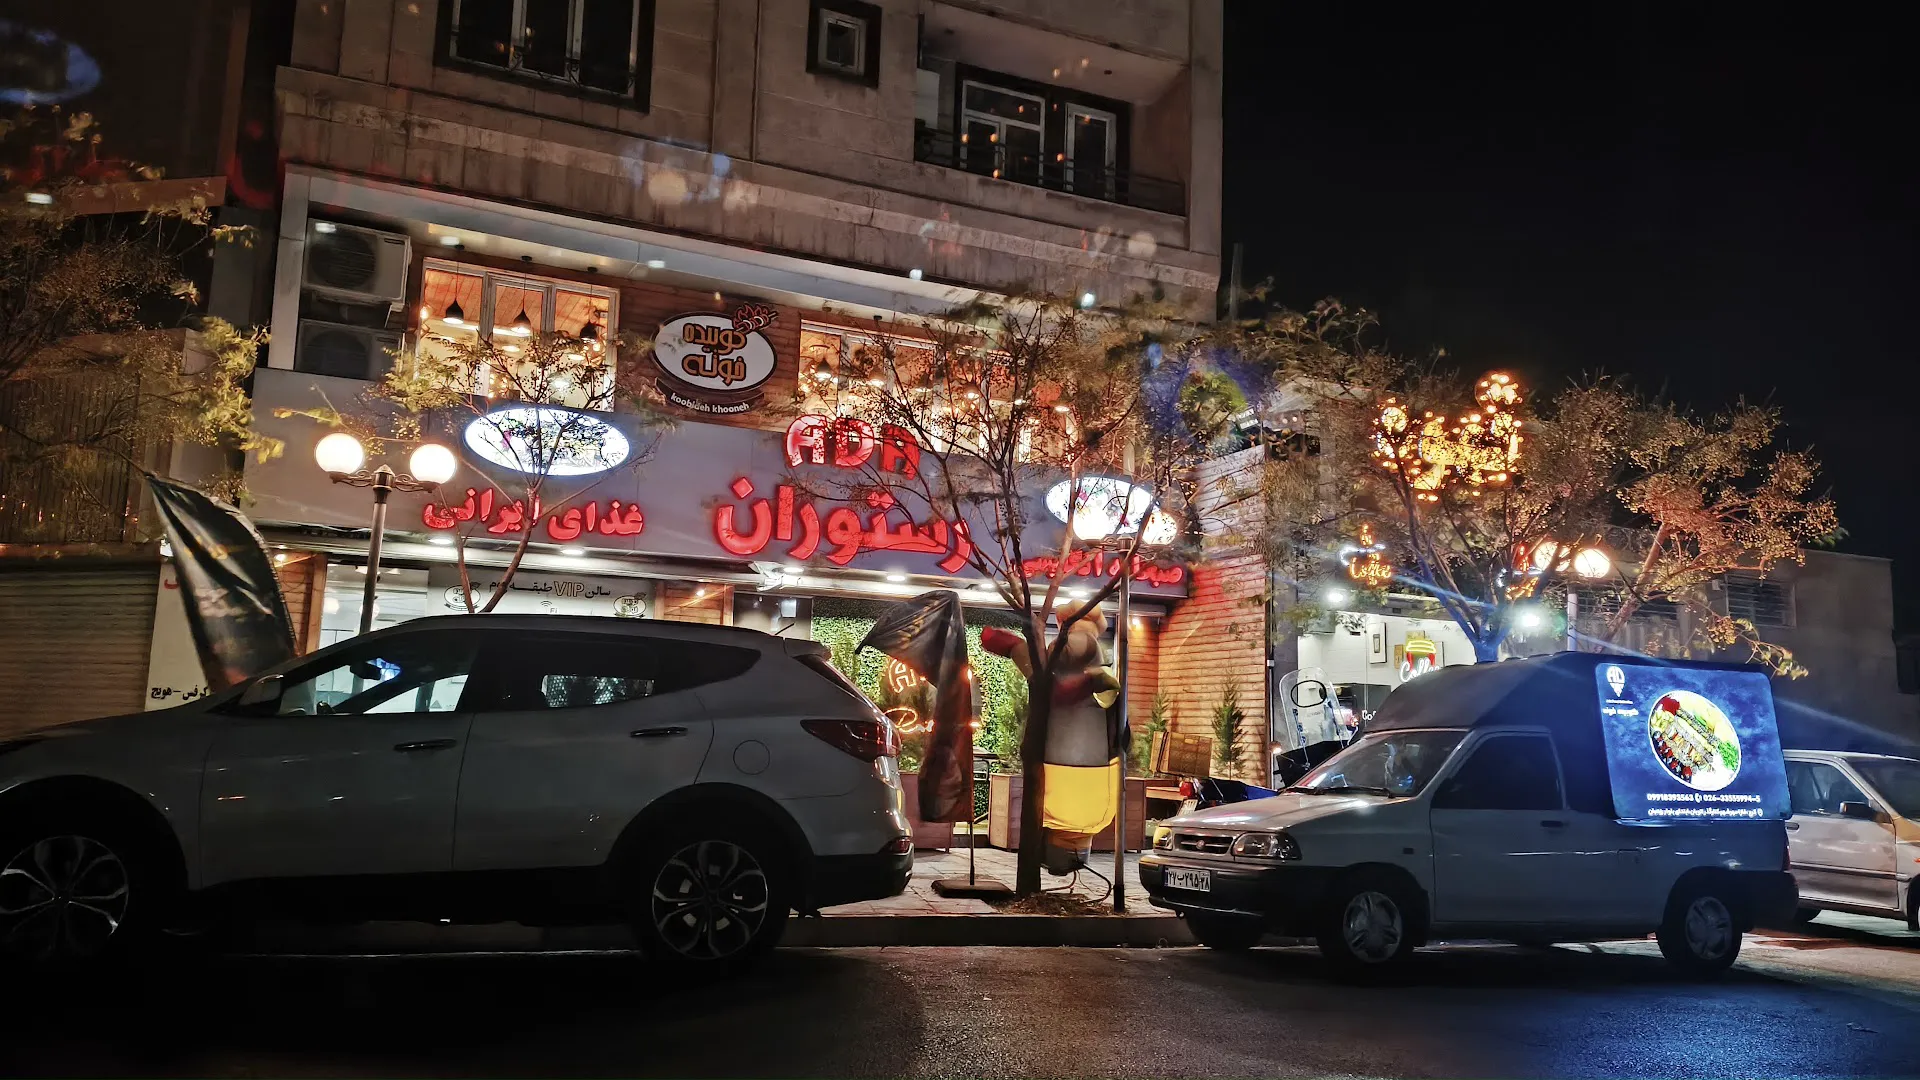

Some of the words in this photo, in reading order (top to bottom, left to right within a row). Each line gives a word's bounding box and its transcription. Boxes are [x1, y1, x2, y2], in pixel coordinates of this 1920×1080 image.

[671, 393, 710, 413] koobideh
[712, 402, 749, 413] khooneh
[786, 414, 920, 480] ADA
[423, 487, 541, 535] ایرانی
[548, 500, 645, 540] غذای
[717, 477, 972, 573] رستوران
[553, 580, 585, 597] VIP
[1107, 554, 1184, 588] صبحاه
[585, 586, 611, 599] سالن
